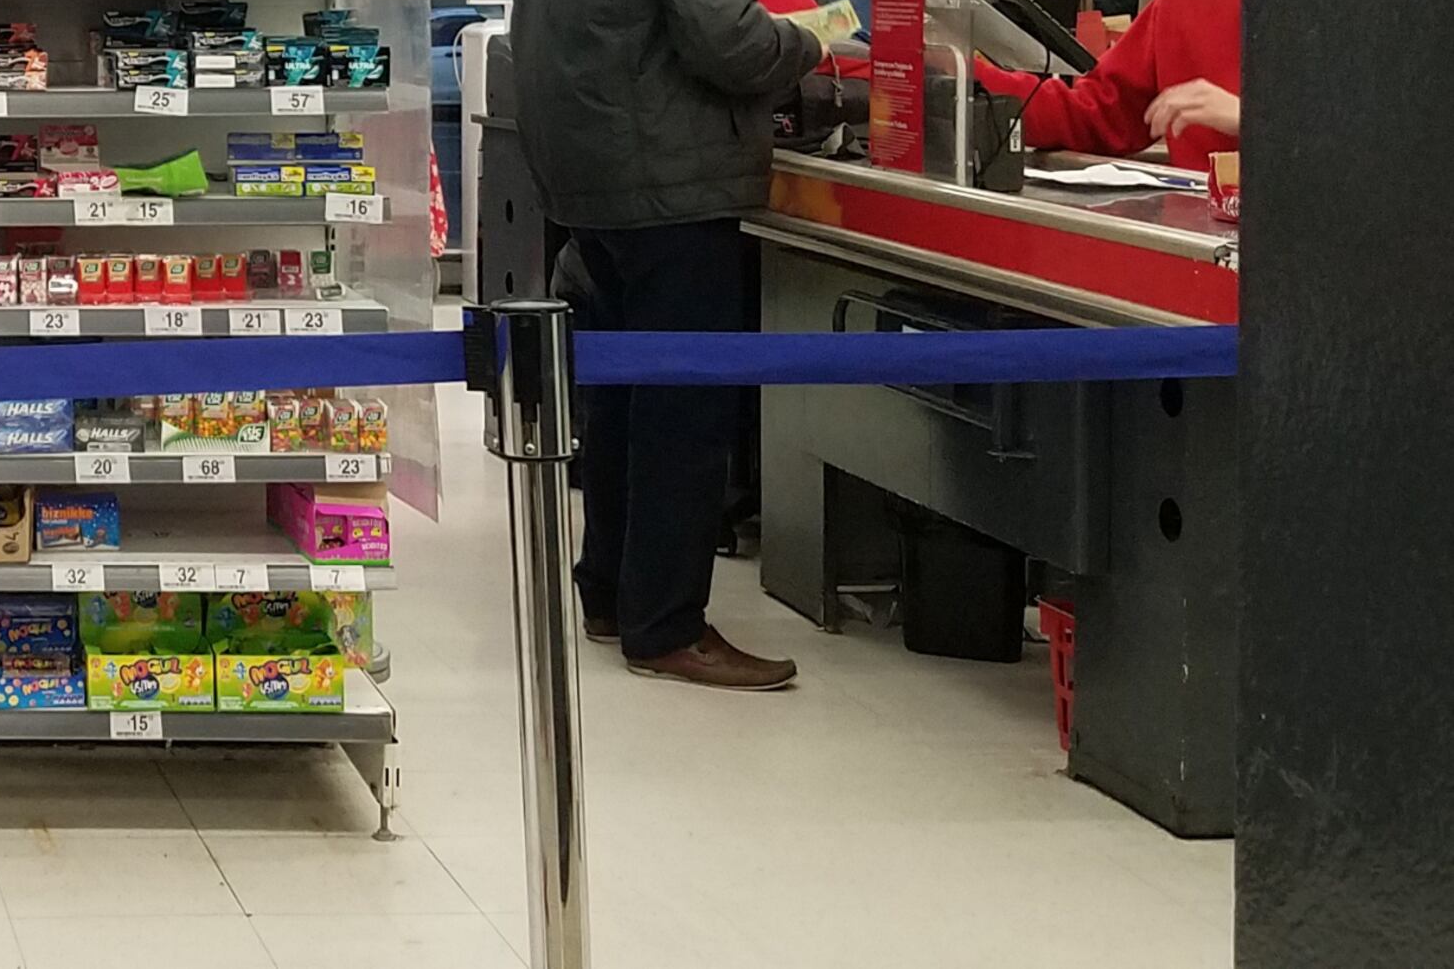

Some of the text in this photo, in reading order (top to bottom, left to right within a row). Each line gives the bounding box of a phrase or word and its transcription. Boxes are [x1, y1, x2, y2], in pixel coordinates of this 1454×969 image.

[7, 403, 54, 417] HALLS
[7, 431, 53, 446] HALLS
[90, 428, 128, 439] HALLS
[120, 657, 182, 684] MOGUL
[249, 657, 313, 685] MOGUL
[130, 715, 148, 731] 15
